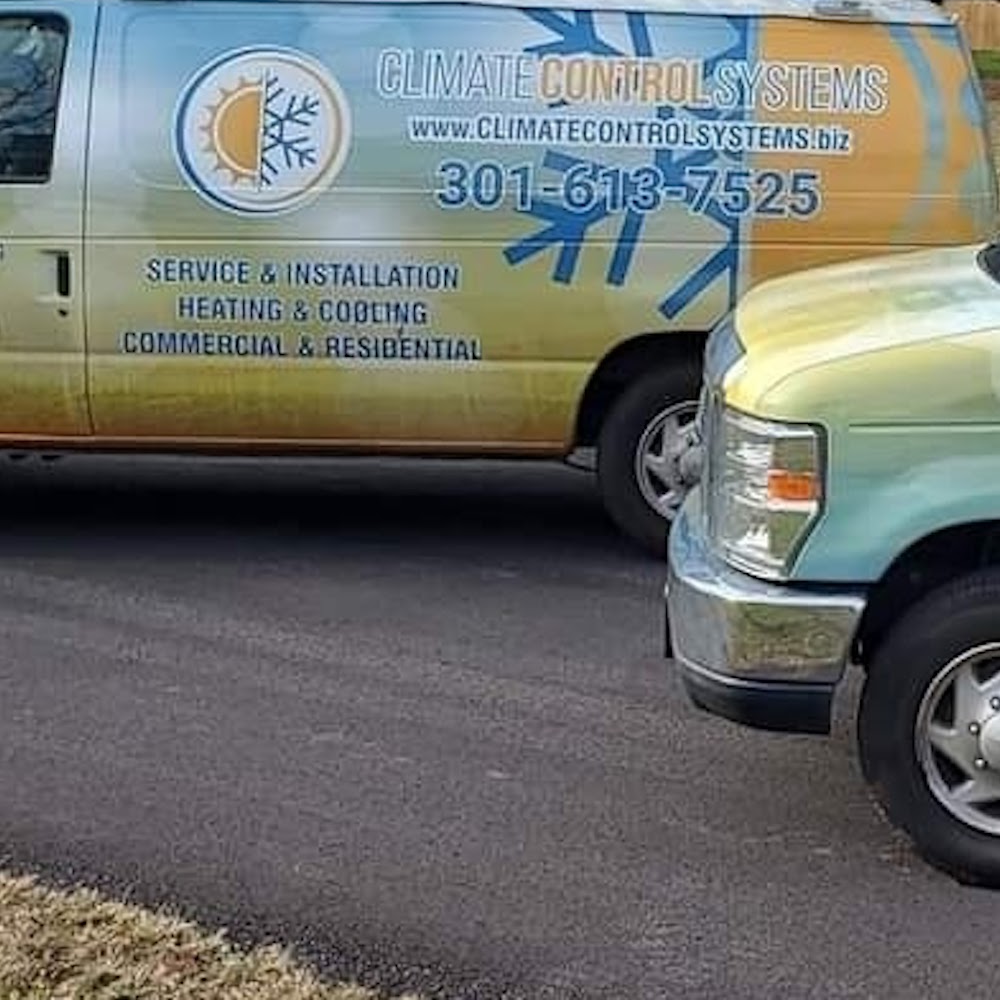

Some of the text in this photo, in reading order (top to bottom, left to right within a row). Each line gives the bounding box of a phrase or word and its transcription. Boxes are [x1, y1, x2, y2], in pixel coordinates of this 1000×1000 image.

[410, 114, 852, 151] www.CLIMATECONTROLSYSTEMS.biz
[436, 160, 821, 217] 301-613-7525
[147, 258, 460, 289] SERVICE & INSTALLATION
[179, 297, 428, 325] HEATING & COOLING
[124, 332, 483, 361] COMMERCIAL & RESIDENTIAL
